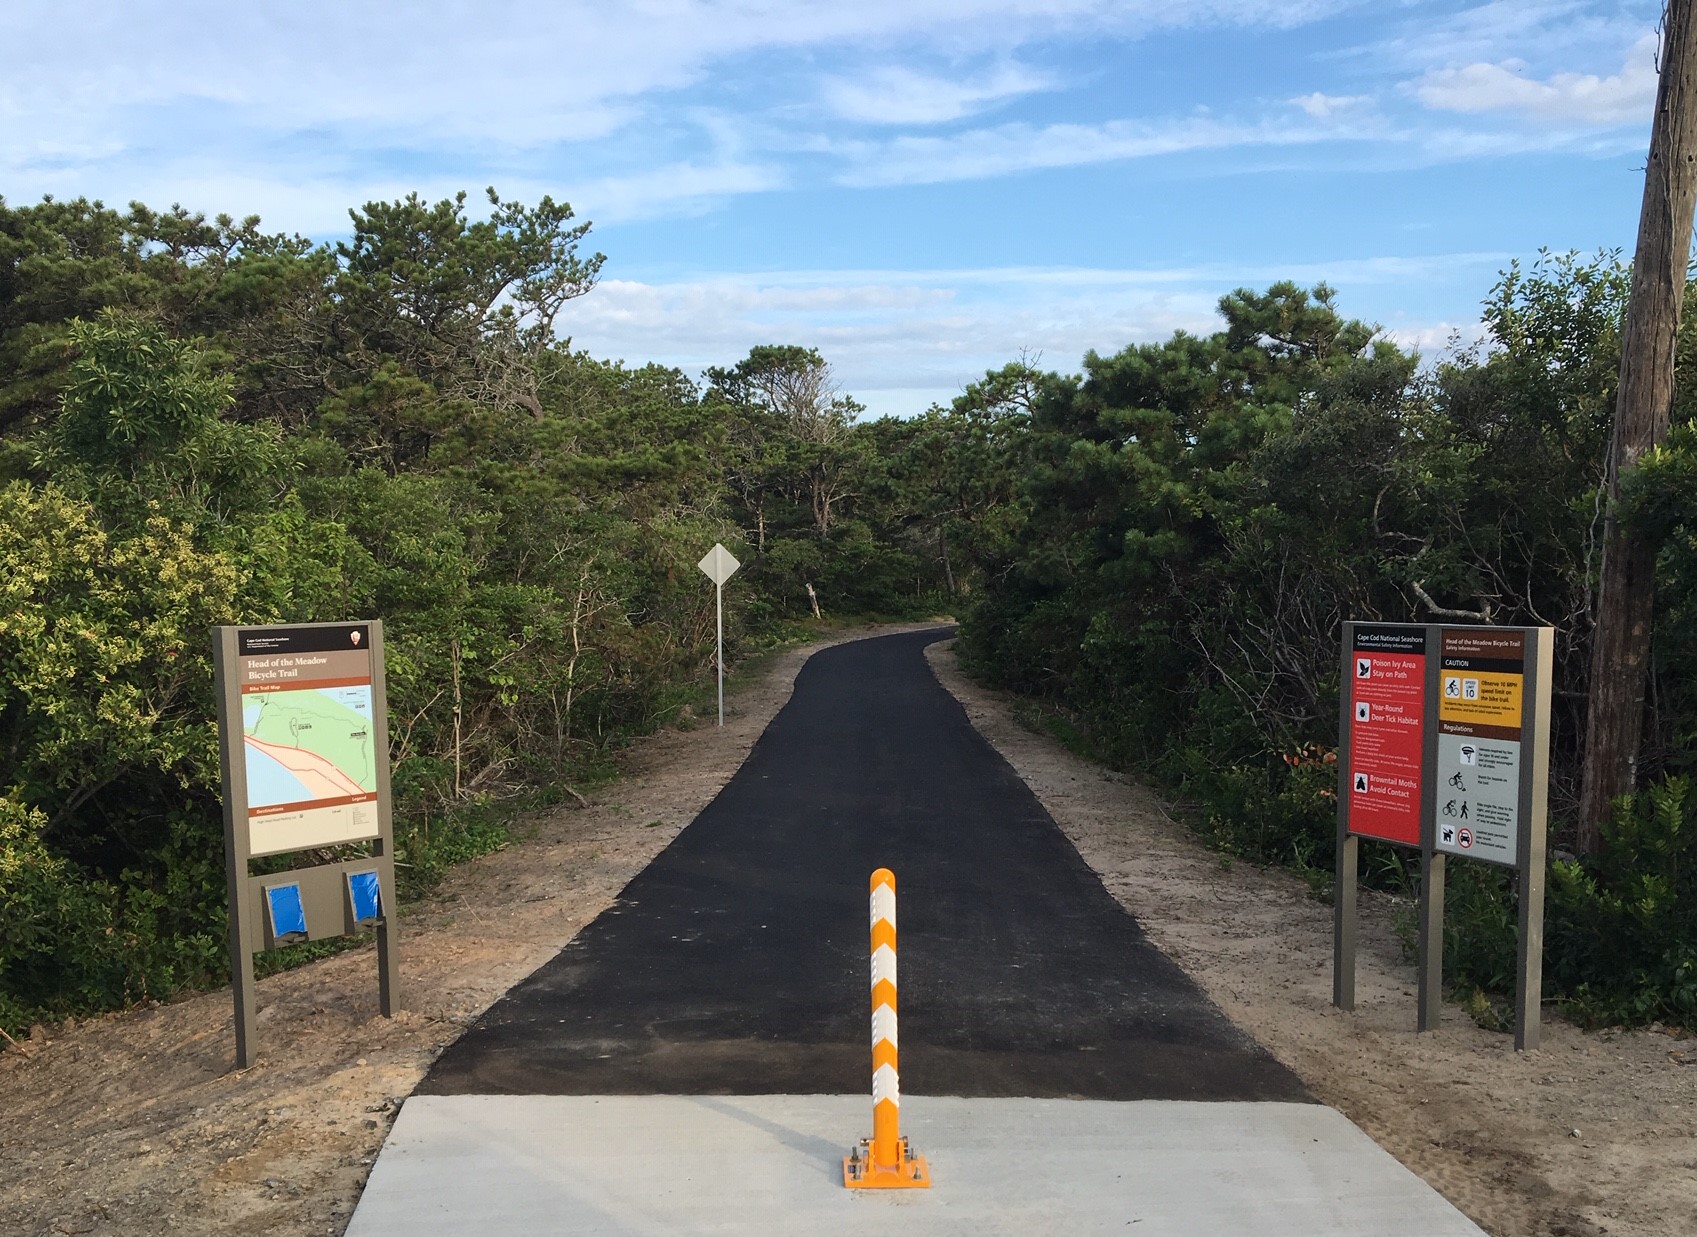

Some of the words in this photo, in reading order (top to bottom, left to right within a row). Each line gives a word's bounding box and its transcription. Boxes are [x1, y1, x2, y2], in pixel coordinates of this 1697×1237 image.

[248, 659, 270, 668] Head
[270, 659, 280, 667] of
[280, 658, 293, 666] the
[294, 656, 328, 666] Meadow
[1392, 660, 1401, 669] Ivy
[248, 670, 277, 680] Bicycle
[278, 669, 298, 678] Trail
[1373, 670, 1384, 679] Stay
[1466, 690, 1474, 698] 10
[1372, 703, 1403, 713] Year-Round
[1386, 715, 1396, 723] Tick
[1398, 716, 1418, 725] Habitat
[1444, 723, 1473, 733] Regulations
[1370, 775, 1397, 785] Browntail
[1398, 779, 1417, 788] Moths
[1370, 785, 1386, 794] Avoid
[1387, 788, 1409, 798] Contact
